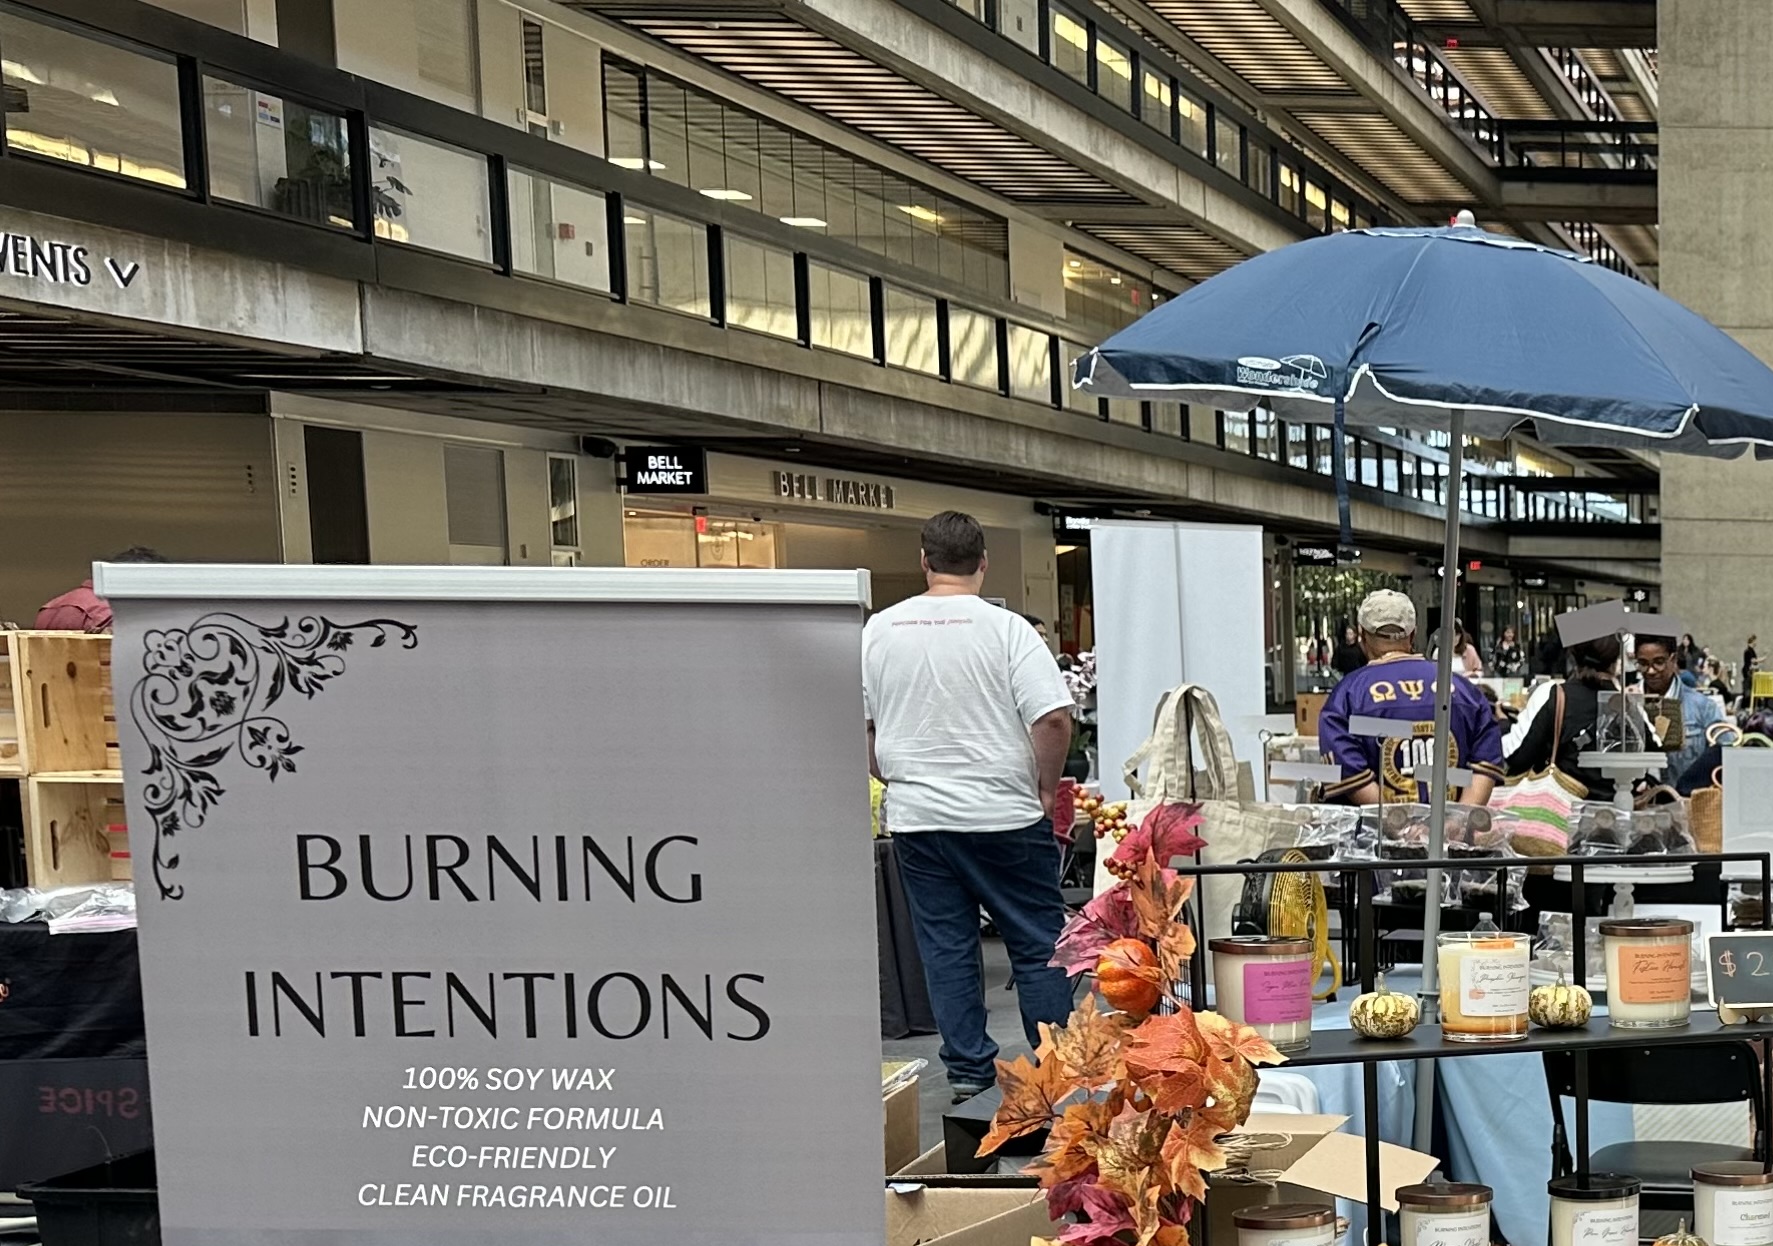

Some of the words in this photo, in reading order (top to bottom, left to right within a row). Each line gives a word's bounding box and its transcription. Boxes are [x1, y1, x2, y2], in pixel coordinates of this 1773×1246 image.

[648, 455, 683, 469] BELL
[636, 471, 693, 485] MARKET
[779, 471, 824, 501] BELL
[832, 478, 898, 509] MARKET
[296, 833, 703, 904] BURNING
[244, 970, 772, 1042] INTENTIONS
[402, 1066, 479, 1091] 100%
[484, 1068, 545, 1092] SOY
[550, 1068, 616, 1092] WAX
[361, 1105, 520, 1131] NON-TOXIC
[525, 1107, 665, 1131] FORMULA
[411, 1145, 617, 1169] ECO-FRIENDLY
[357, 1183, 450, 1208] CLEAN
[455, 1184, 627, 1209] FRAGRANCE
[631, 1185, 678, 1210] OIL
